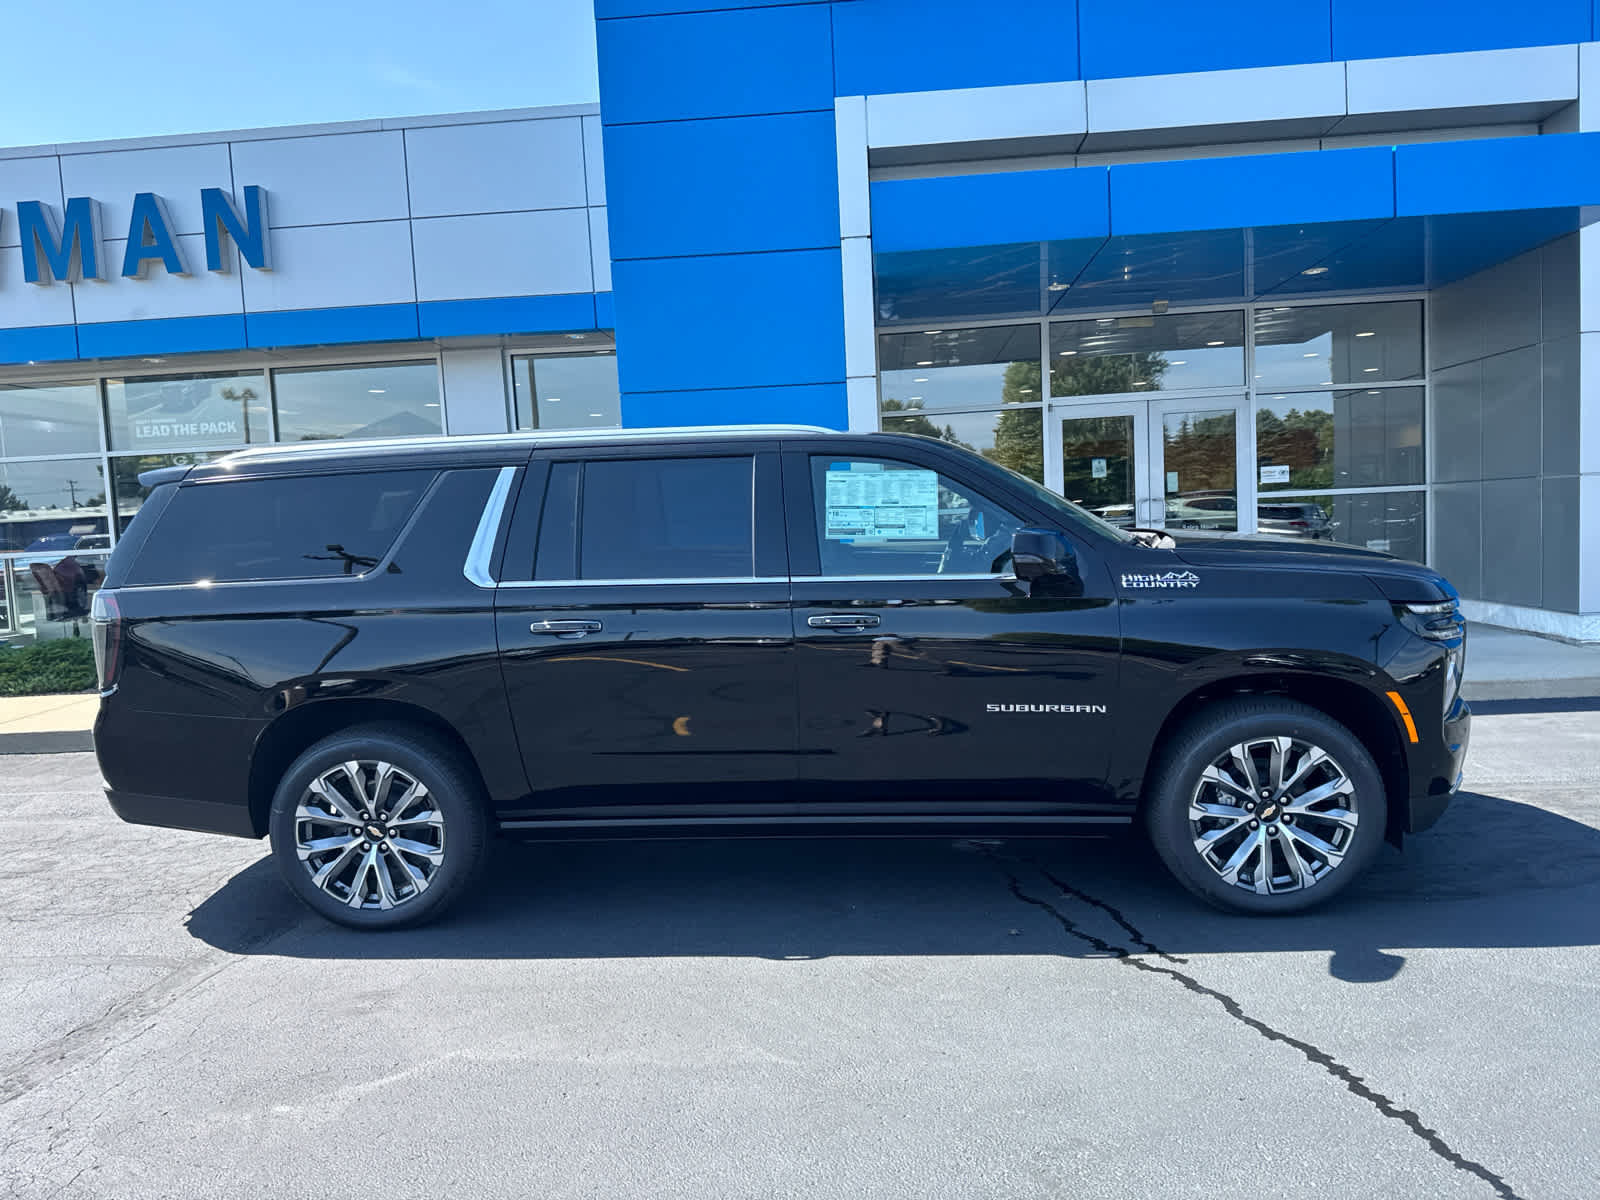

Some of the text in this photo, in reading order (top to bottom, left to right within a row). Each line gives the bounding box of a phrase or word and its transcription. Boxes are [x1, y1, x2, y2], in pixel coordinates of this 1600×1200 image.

[0, 185, 273, 286] MAN
[136, 421, 237, 438] LEAD THE PACK
[1121, 573, 1161, 581] HIGH
[1121, 580, 1200, 588] COUNTRY
[986, 704, 1107, 713] SUBURBAN
